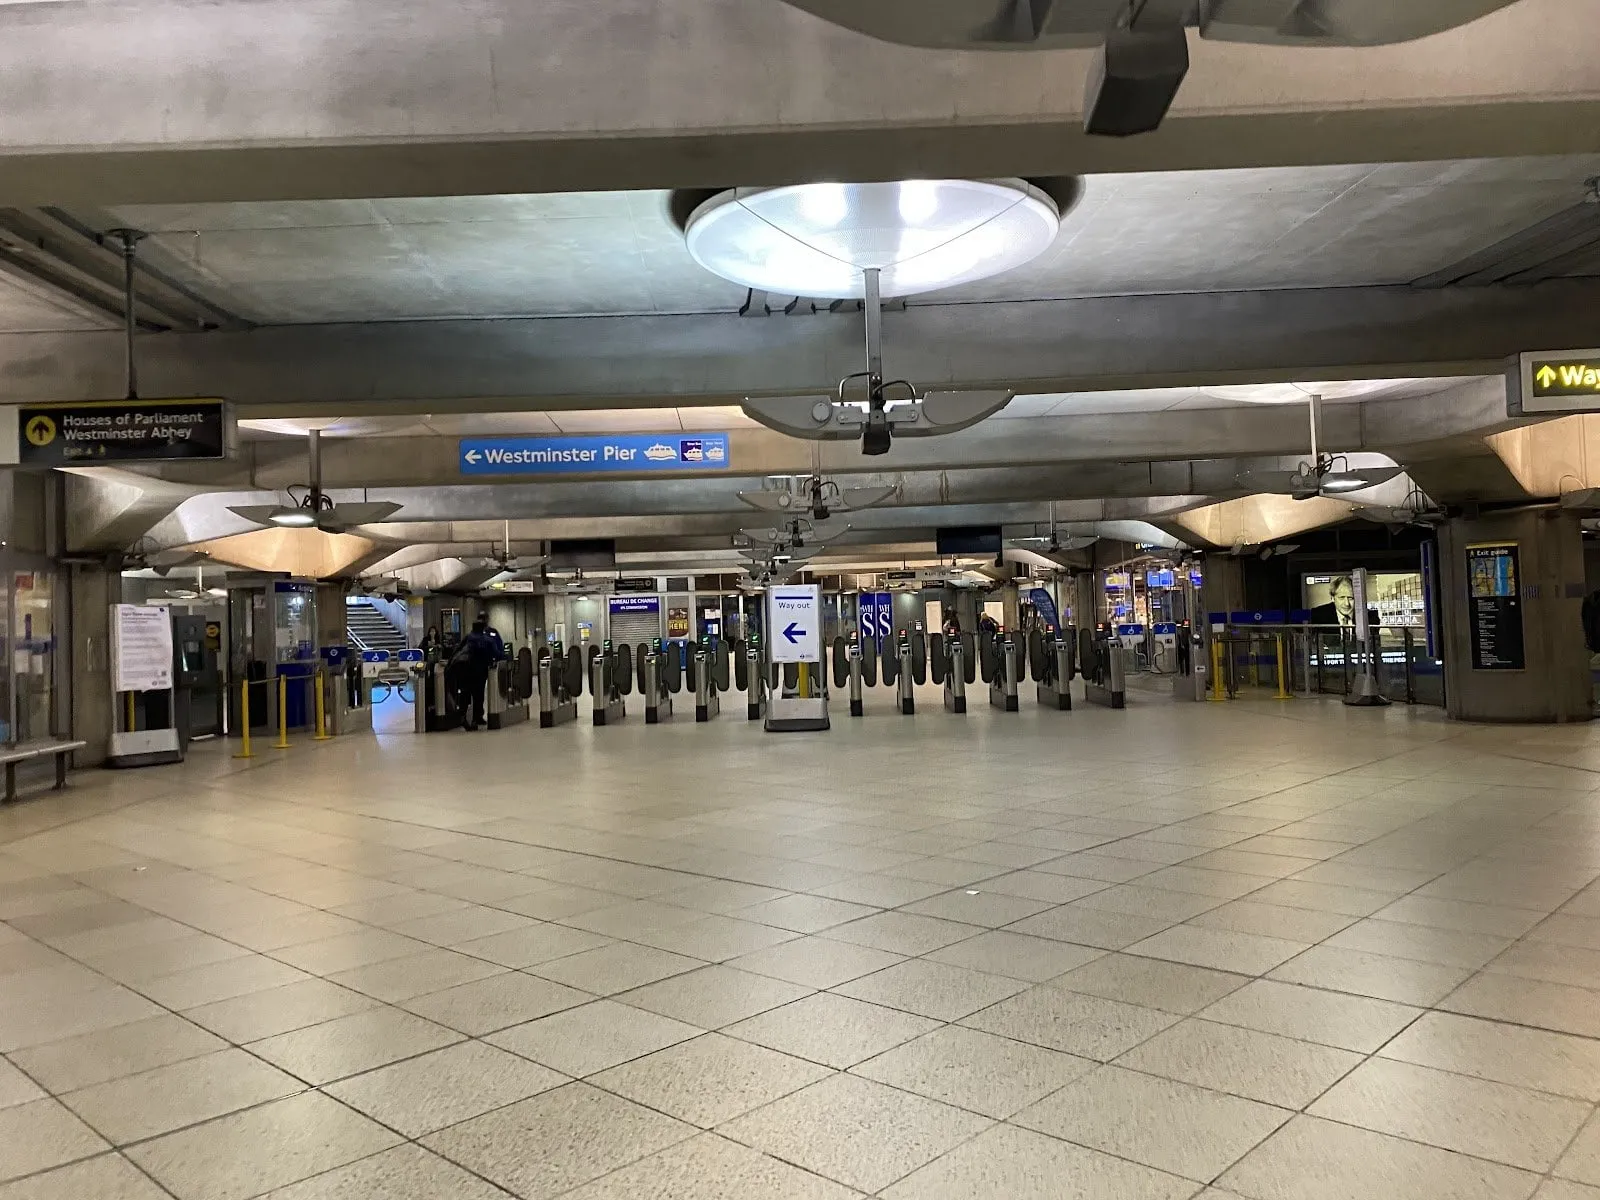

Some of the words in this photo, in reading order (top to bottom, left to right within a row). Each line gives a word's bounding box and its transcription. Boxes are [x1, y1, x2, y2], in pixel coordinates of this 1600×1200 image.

[63, 415, 112, 426] Houses
[115, 413, 131, 425] of
[134, 412, 204, 424] Parliament
[63, 428, 147, 441] Westminster
[151, 427, 193, 441] Abbey
[484, 447, 597, 464] Westminster
[604, 446, 637, 461] Pier
[778, 602, 795, 610] Way
